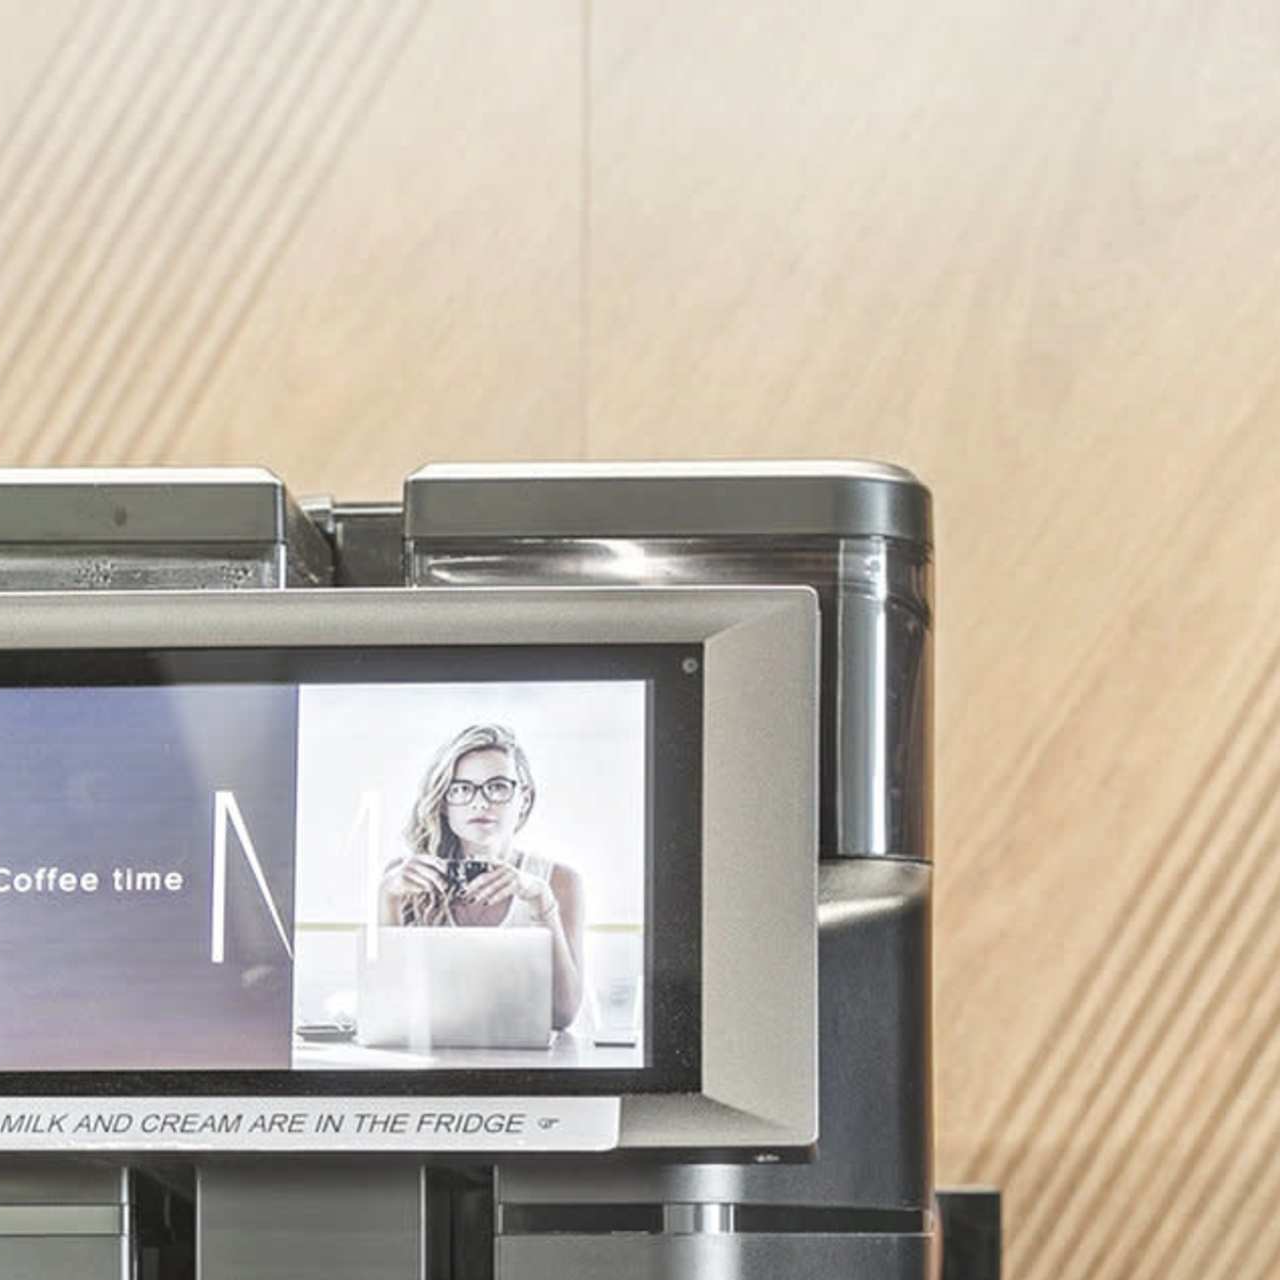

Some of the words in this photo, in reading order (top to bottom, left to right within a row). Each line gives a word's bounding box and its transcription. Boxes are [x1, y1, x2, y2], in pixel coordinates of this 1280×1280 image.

[112, 867, 183, 891] time
[0, 1113, 68, 1133] MILK
[73, 1113, 133, 1133] AND
[140, 1113, 243, 1134] CREAM
[248, 1113, 308, 1133] ARE
[314, 1113, 345, 1133] IN
[354, 1113, 411, 1133] THE
[416, 1113, 526, 1134] FRIDGE
